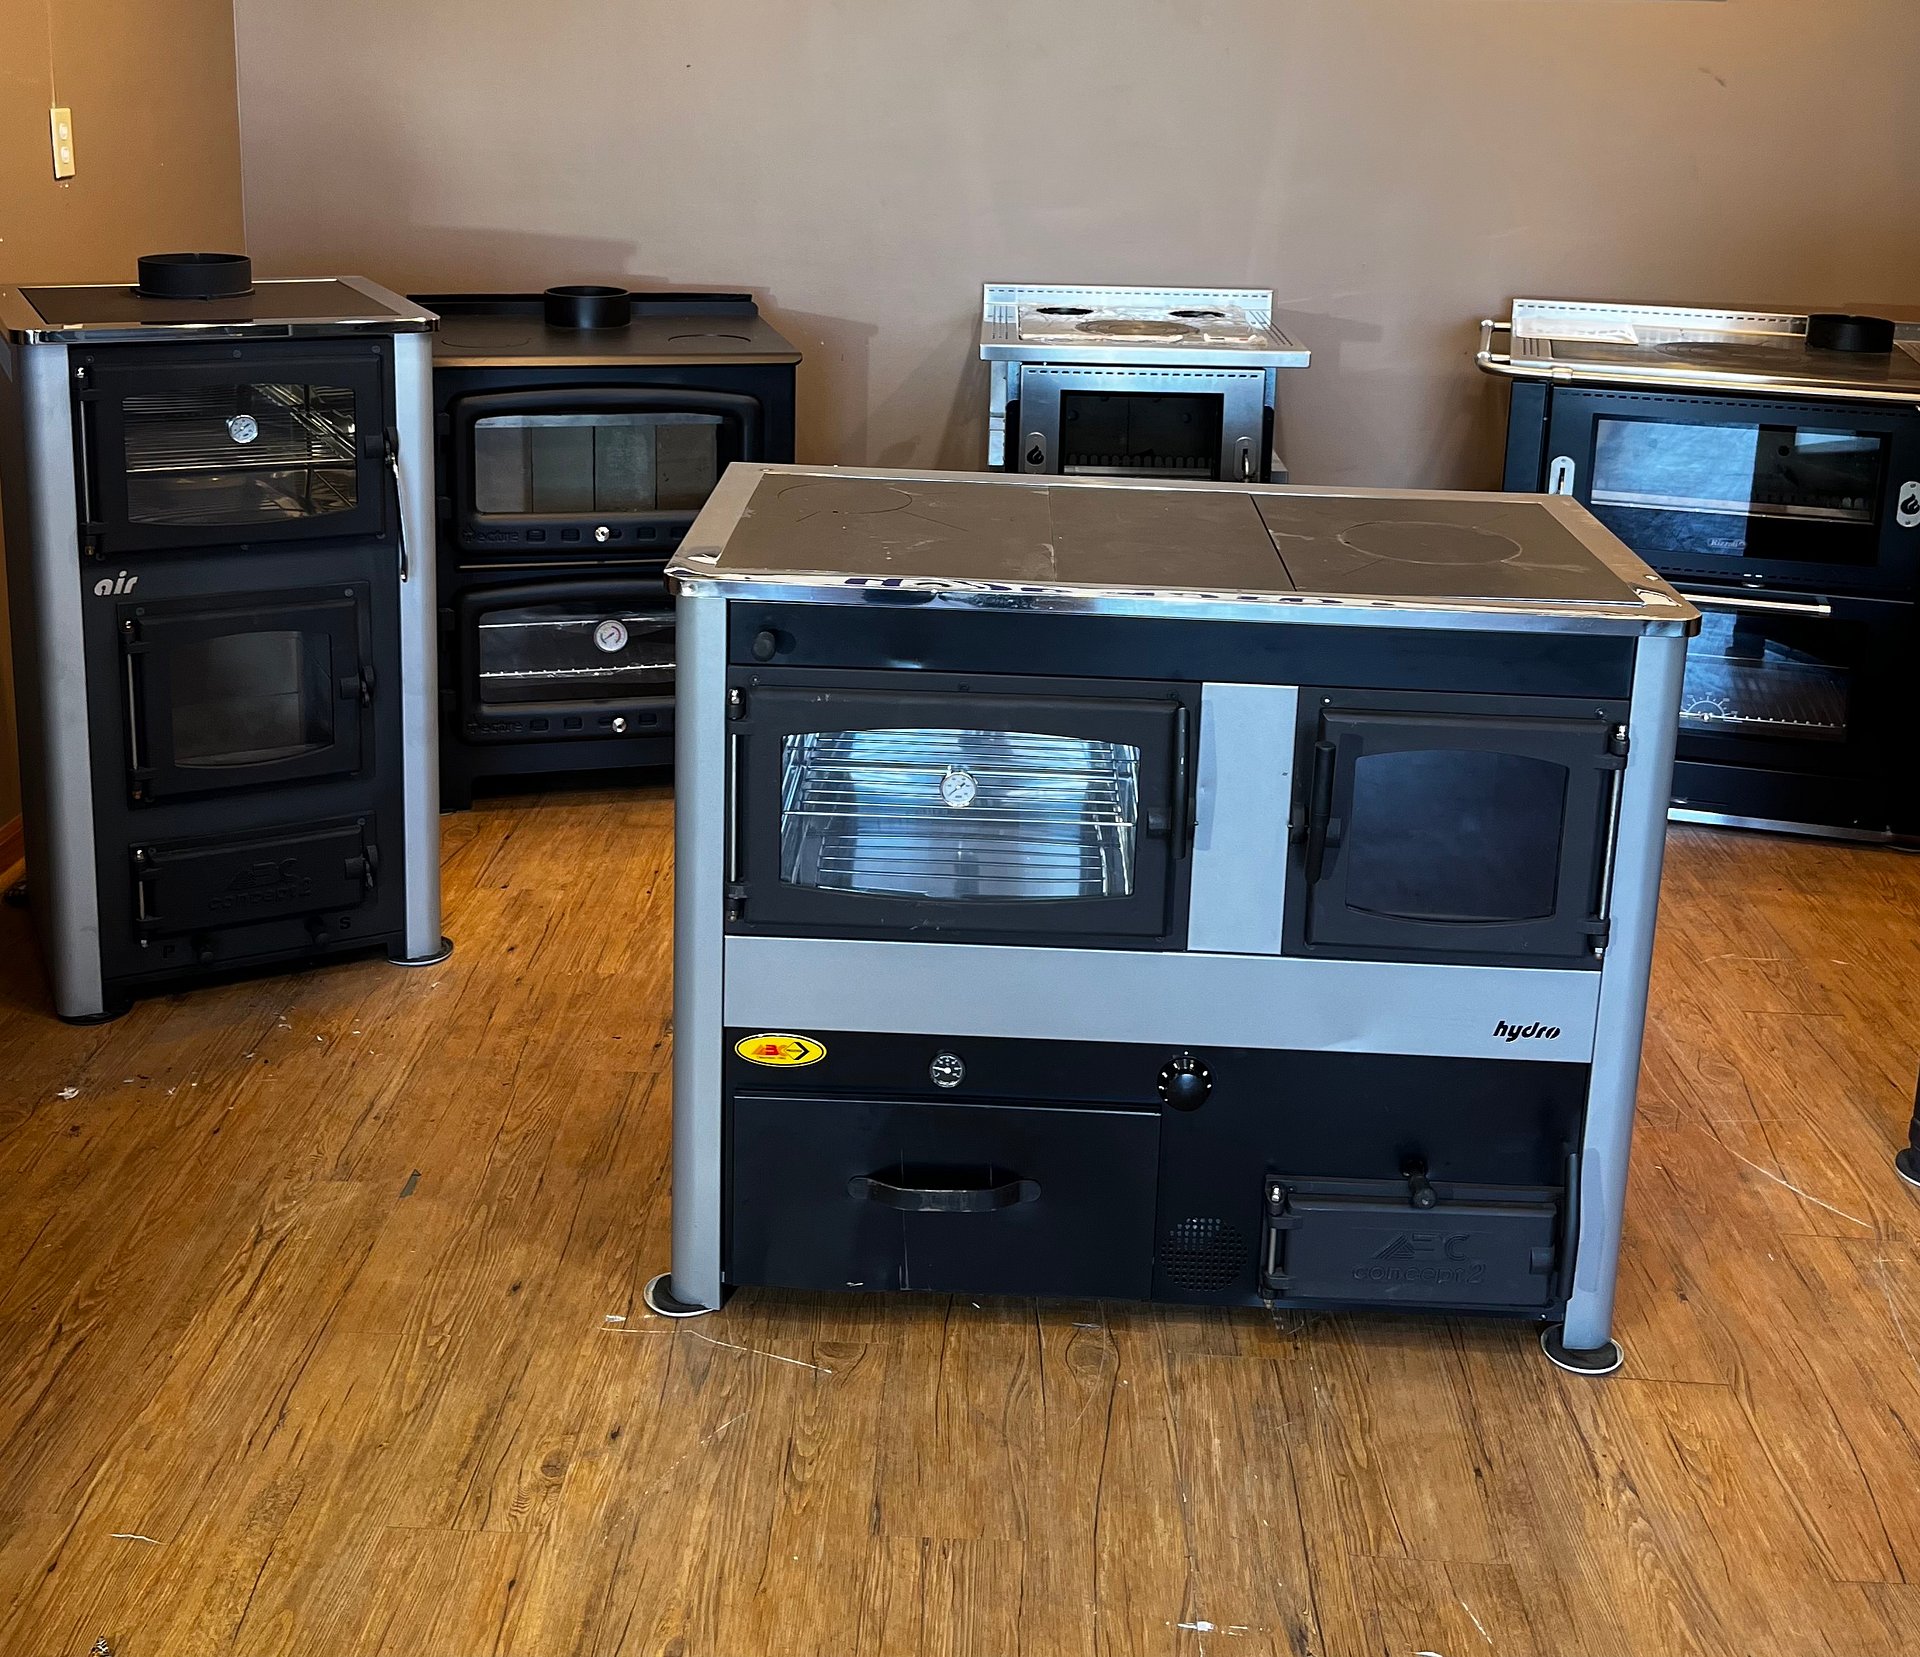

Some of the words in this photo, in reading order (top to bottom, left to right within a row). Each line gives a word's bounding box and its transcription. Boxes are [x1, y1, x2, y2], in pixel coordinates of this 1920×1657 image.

[94, 570, 138, 596] air
[1493, 1020, 1561, 1042] hydro
[1352, 1264, 1465, 1284] concept
[1466, 1263, 1487, 1284] 2
